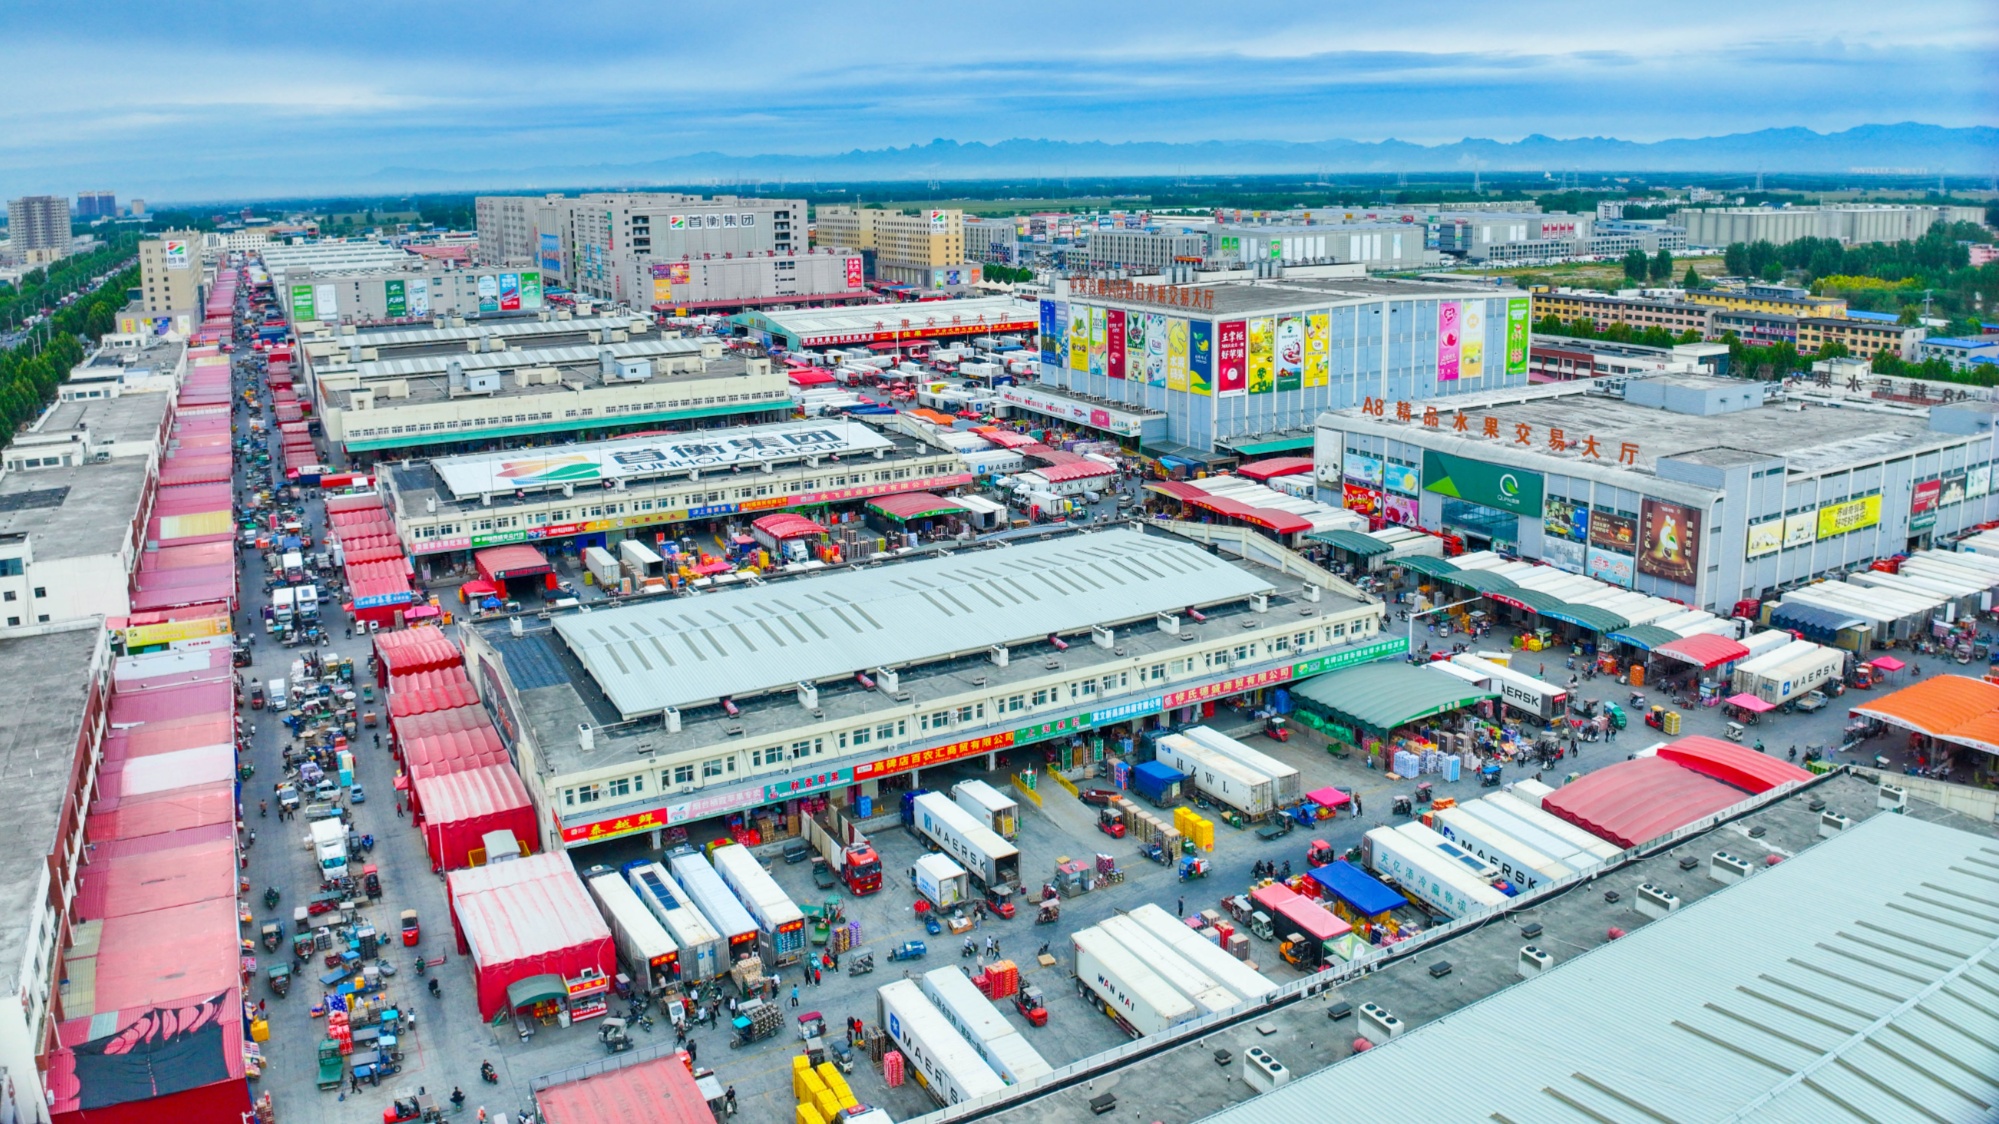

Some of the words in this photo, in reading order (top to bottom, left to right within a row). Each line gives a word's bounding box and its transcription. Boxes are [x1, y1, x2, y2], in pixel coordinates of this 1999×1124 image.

[688, 213, 755, 229] 首衡集团
[612, 428, 845, 465] 首衡集团
[1362, 396, 1640, 465] A8精品水果交易大厅
[621, 452, 753, 474] SUNHOLA
[757, 441, 851, 461] GROUP
[988, 461, 1027, 472] MAERSK
[1792, 661, 1838, 689] MAERSK
[934, 823, 986, 872] MAERSK
[1097, 972, 1116, 995] WAN
[1118, 991, 1135, 1012] HAI
[903, 1031, 963, 1104] MAERS
